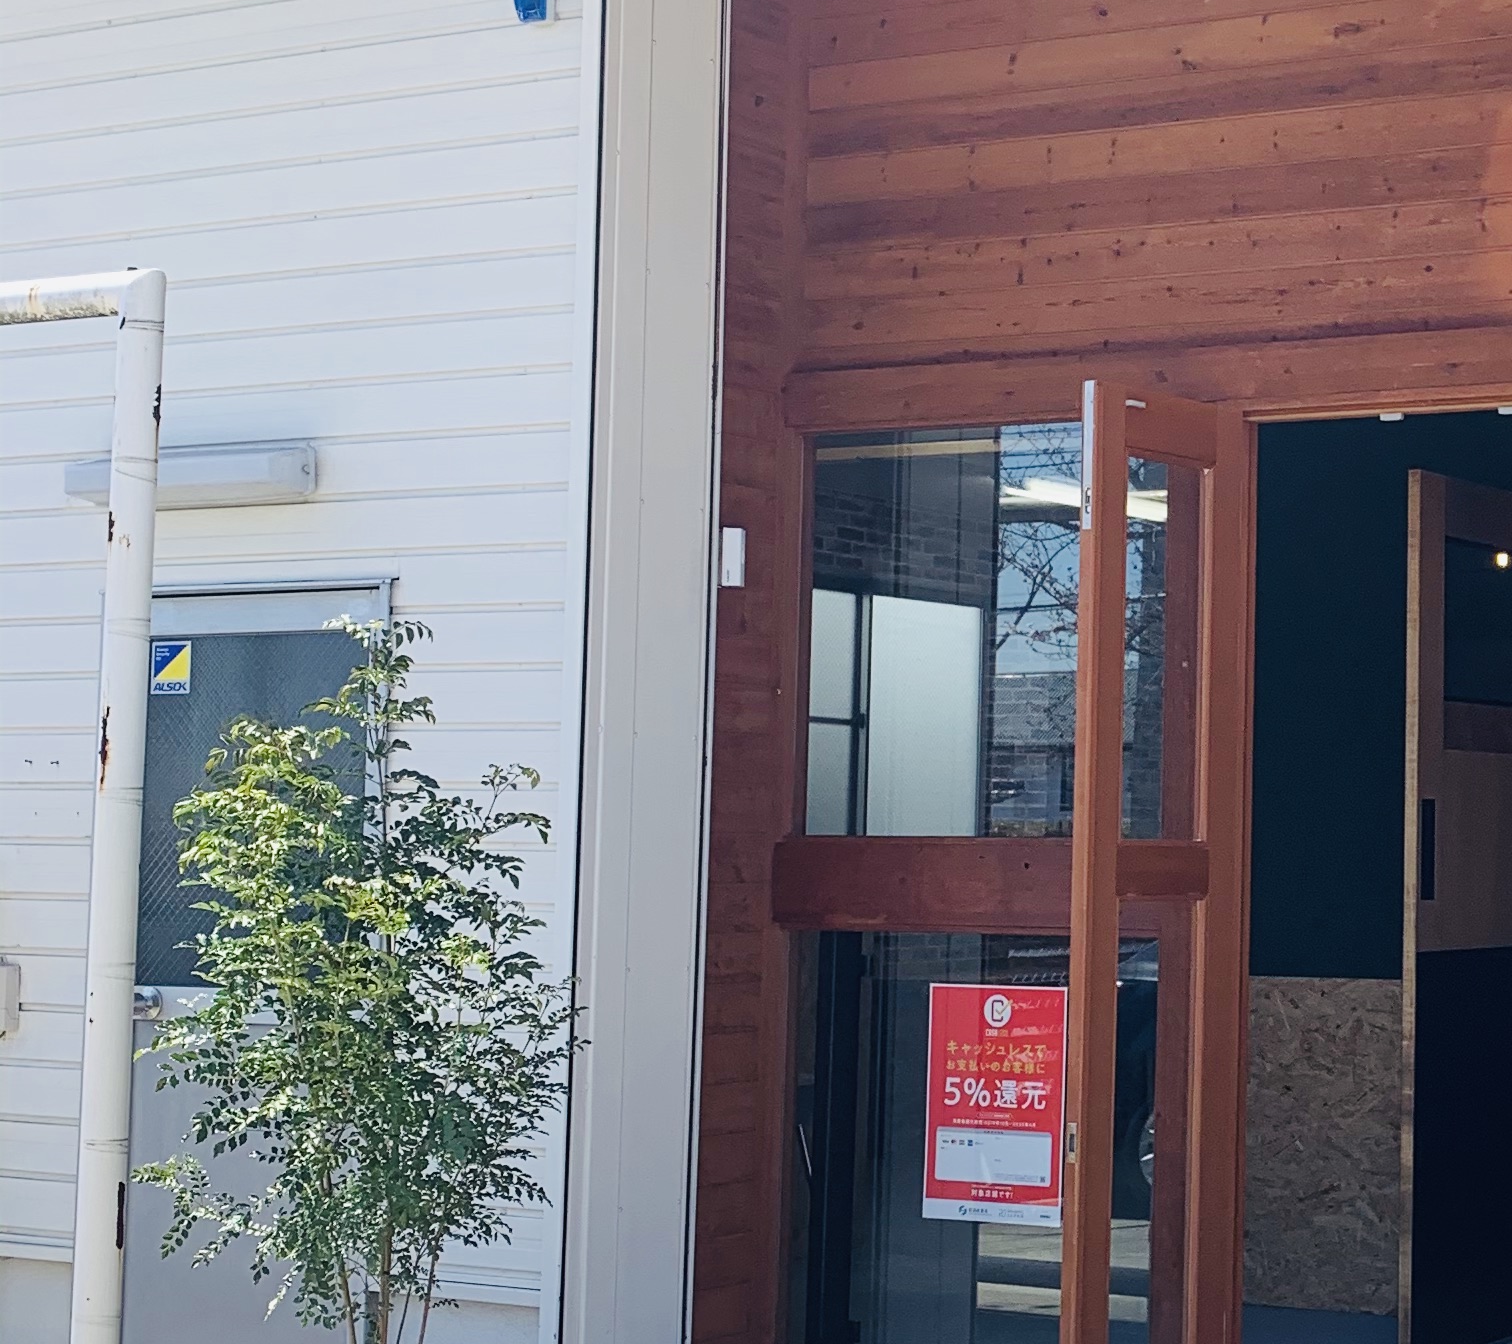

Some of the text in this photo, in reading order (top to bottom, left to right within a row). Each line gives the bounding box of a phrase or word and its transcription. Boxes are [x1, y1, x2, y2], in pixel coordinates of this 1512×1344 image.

[153, 681, 187, 692] ALSOK
[946, 1039, 1047, 1058] キャッシュレスで
[943, 1076, 1047, 1110] 5%還元
